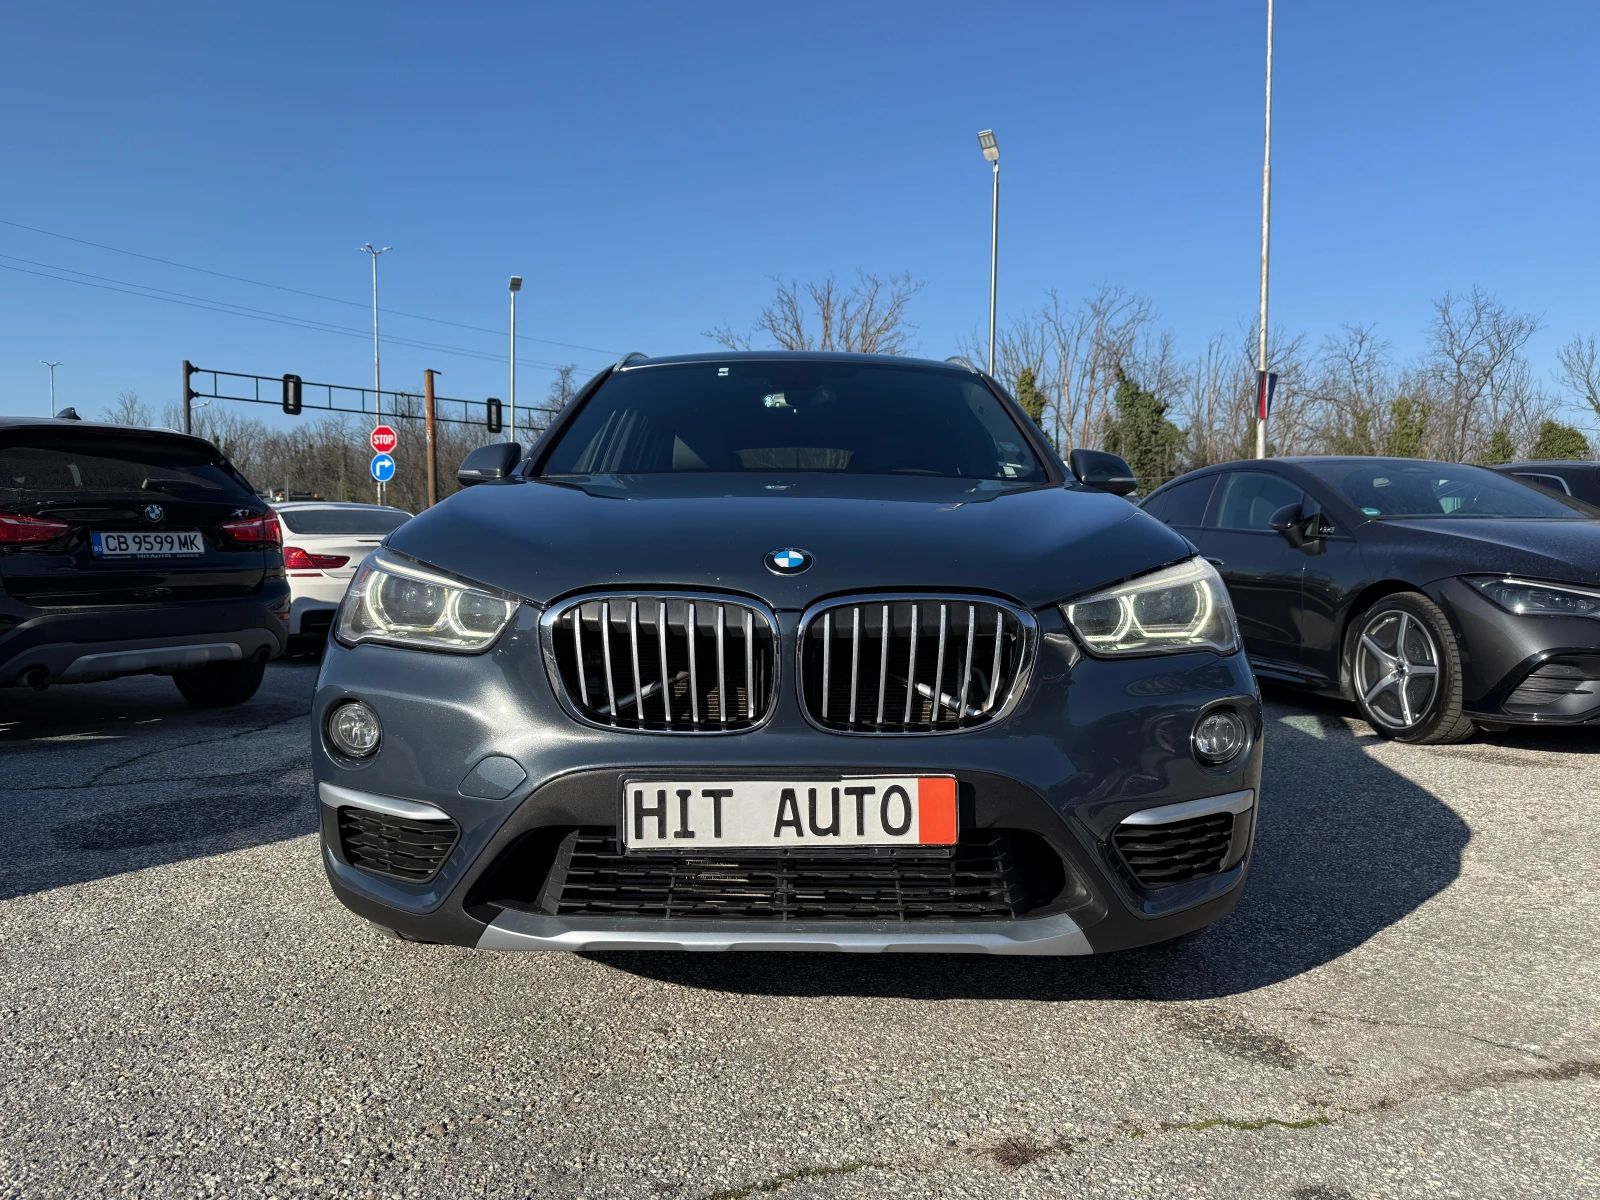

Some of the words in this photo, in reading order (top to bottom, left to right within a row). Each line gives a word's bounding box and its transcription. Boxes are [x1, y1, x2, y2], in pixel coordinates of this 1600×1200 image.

[373, 434, 394, 445] STOP
[105, 535, 129, 552] CB
[132, 535, 174, 552] 9599
[177, 535, 200, 551] MK
[633, 788, 734, 840] HIT
[773, 784, 912, 838] AUTO
